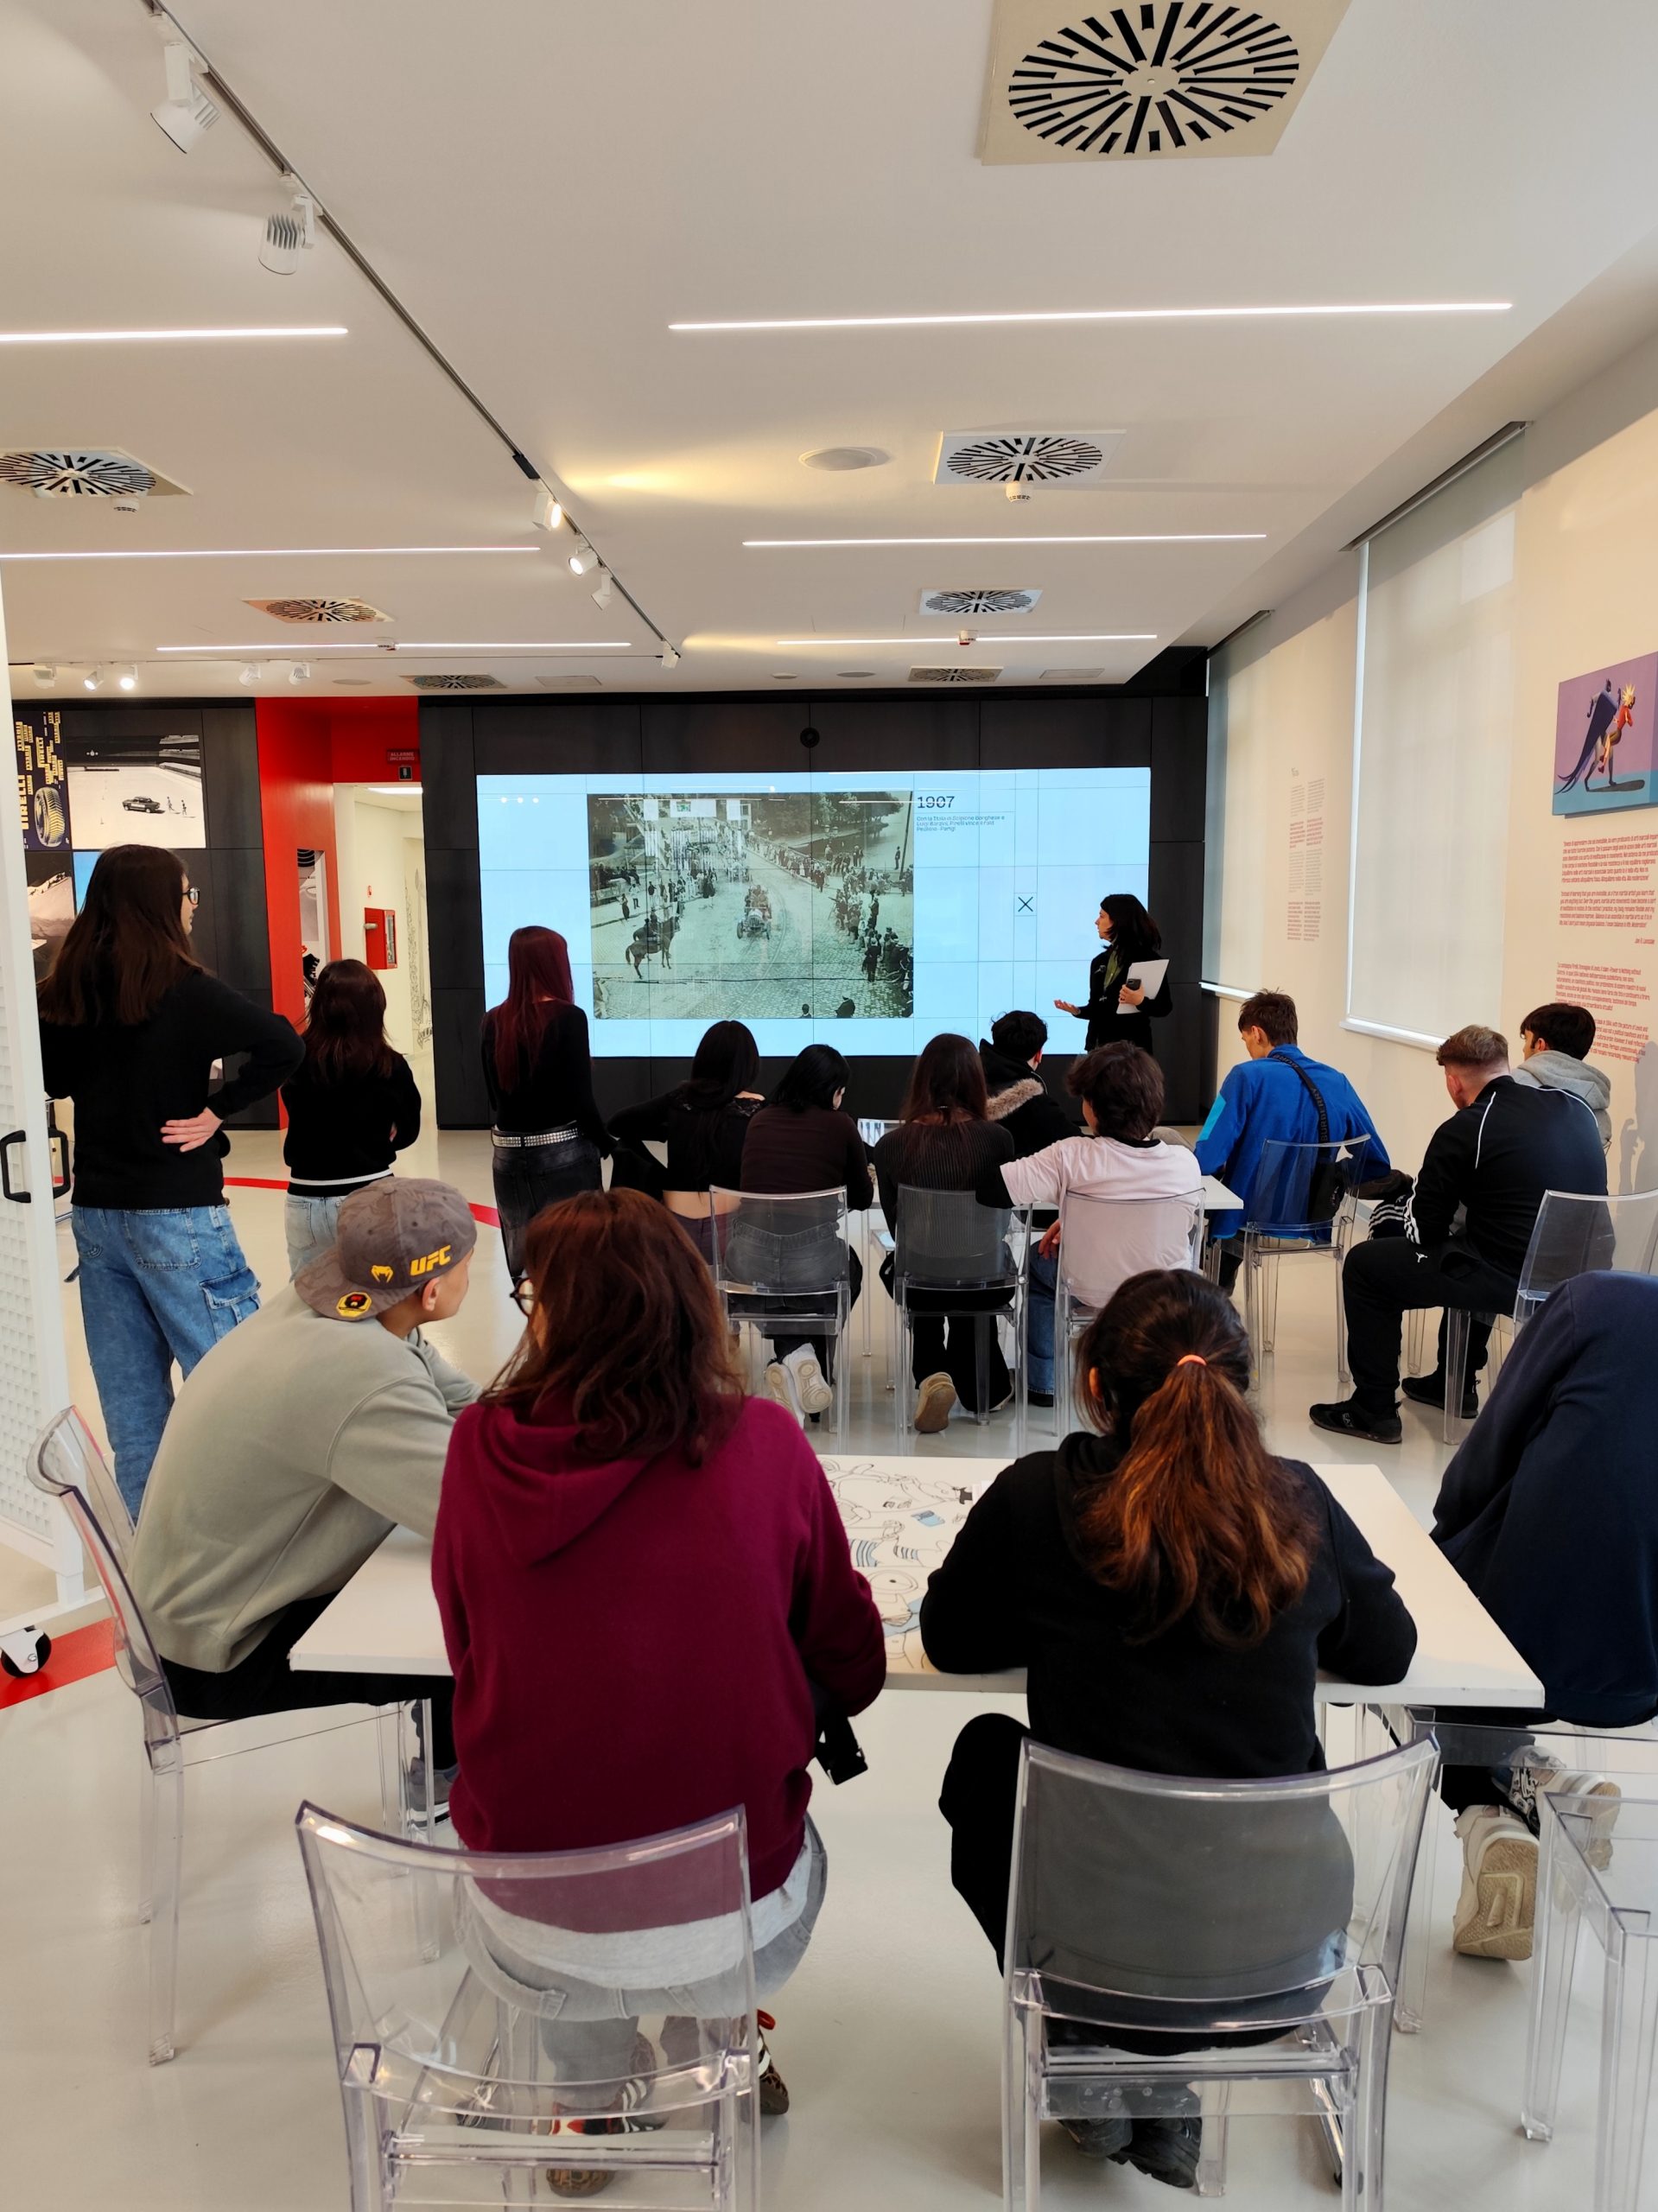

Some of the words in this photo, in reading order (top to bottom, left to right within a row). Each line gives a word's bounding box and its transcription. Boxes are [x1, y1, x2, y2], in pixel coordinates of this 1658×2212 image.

[918, 796, 955, 809] 1907
[1312, 1088, 1329, 1141] BURBERRY
[410, 1244, 452, 1276] UFC
